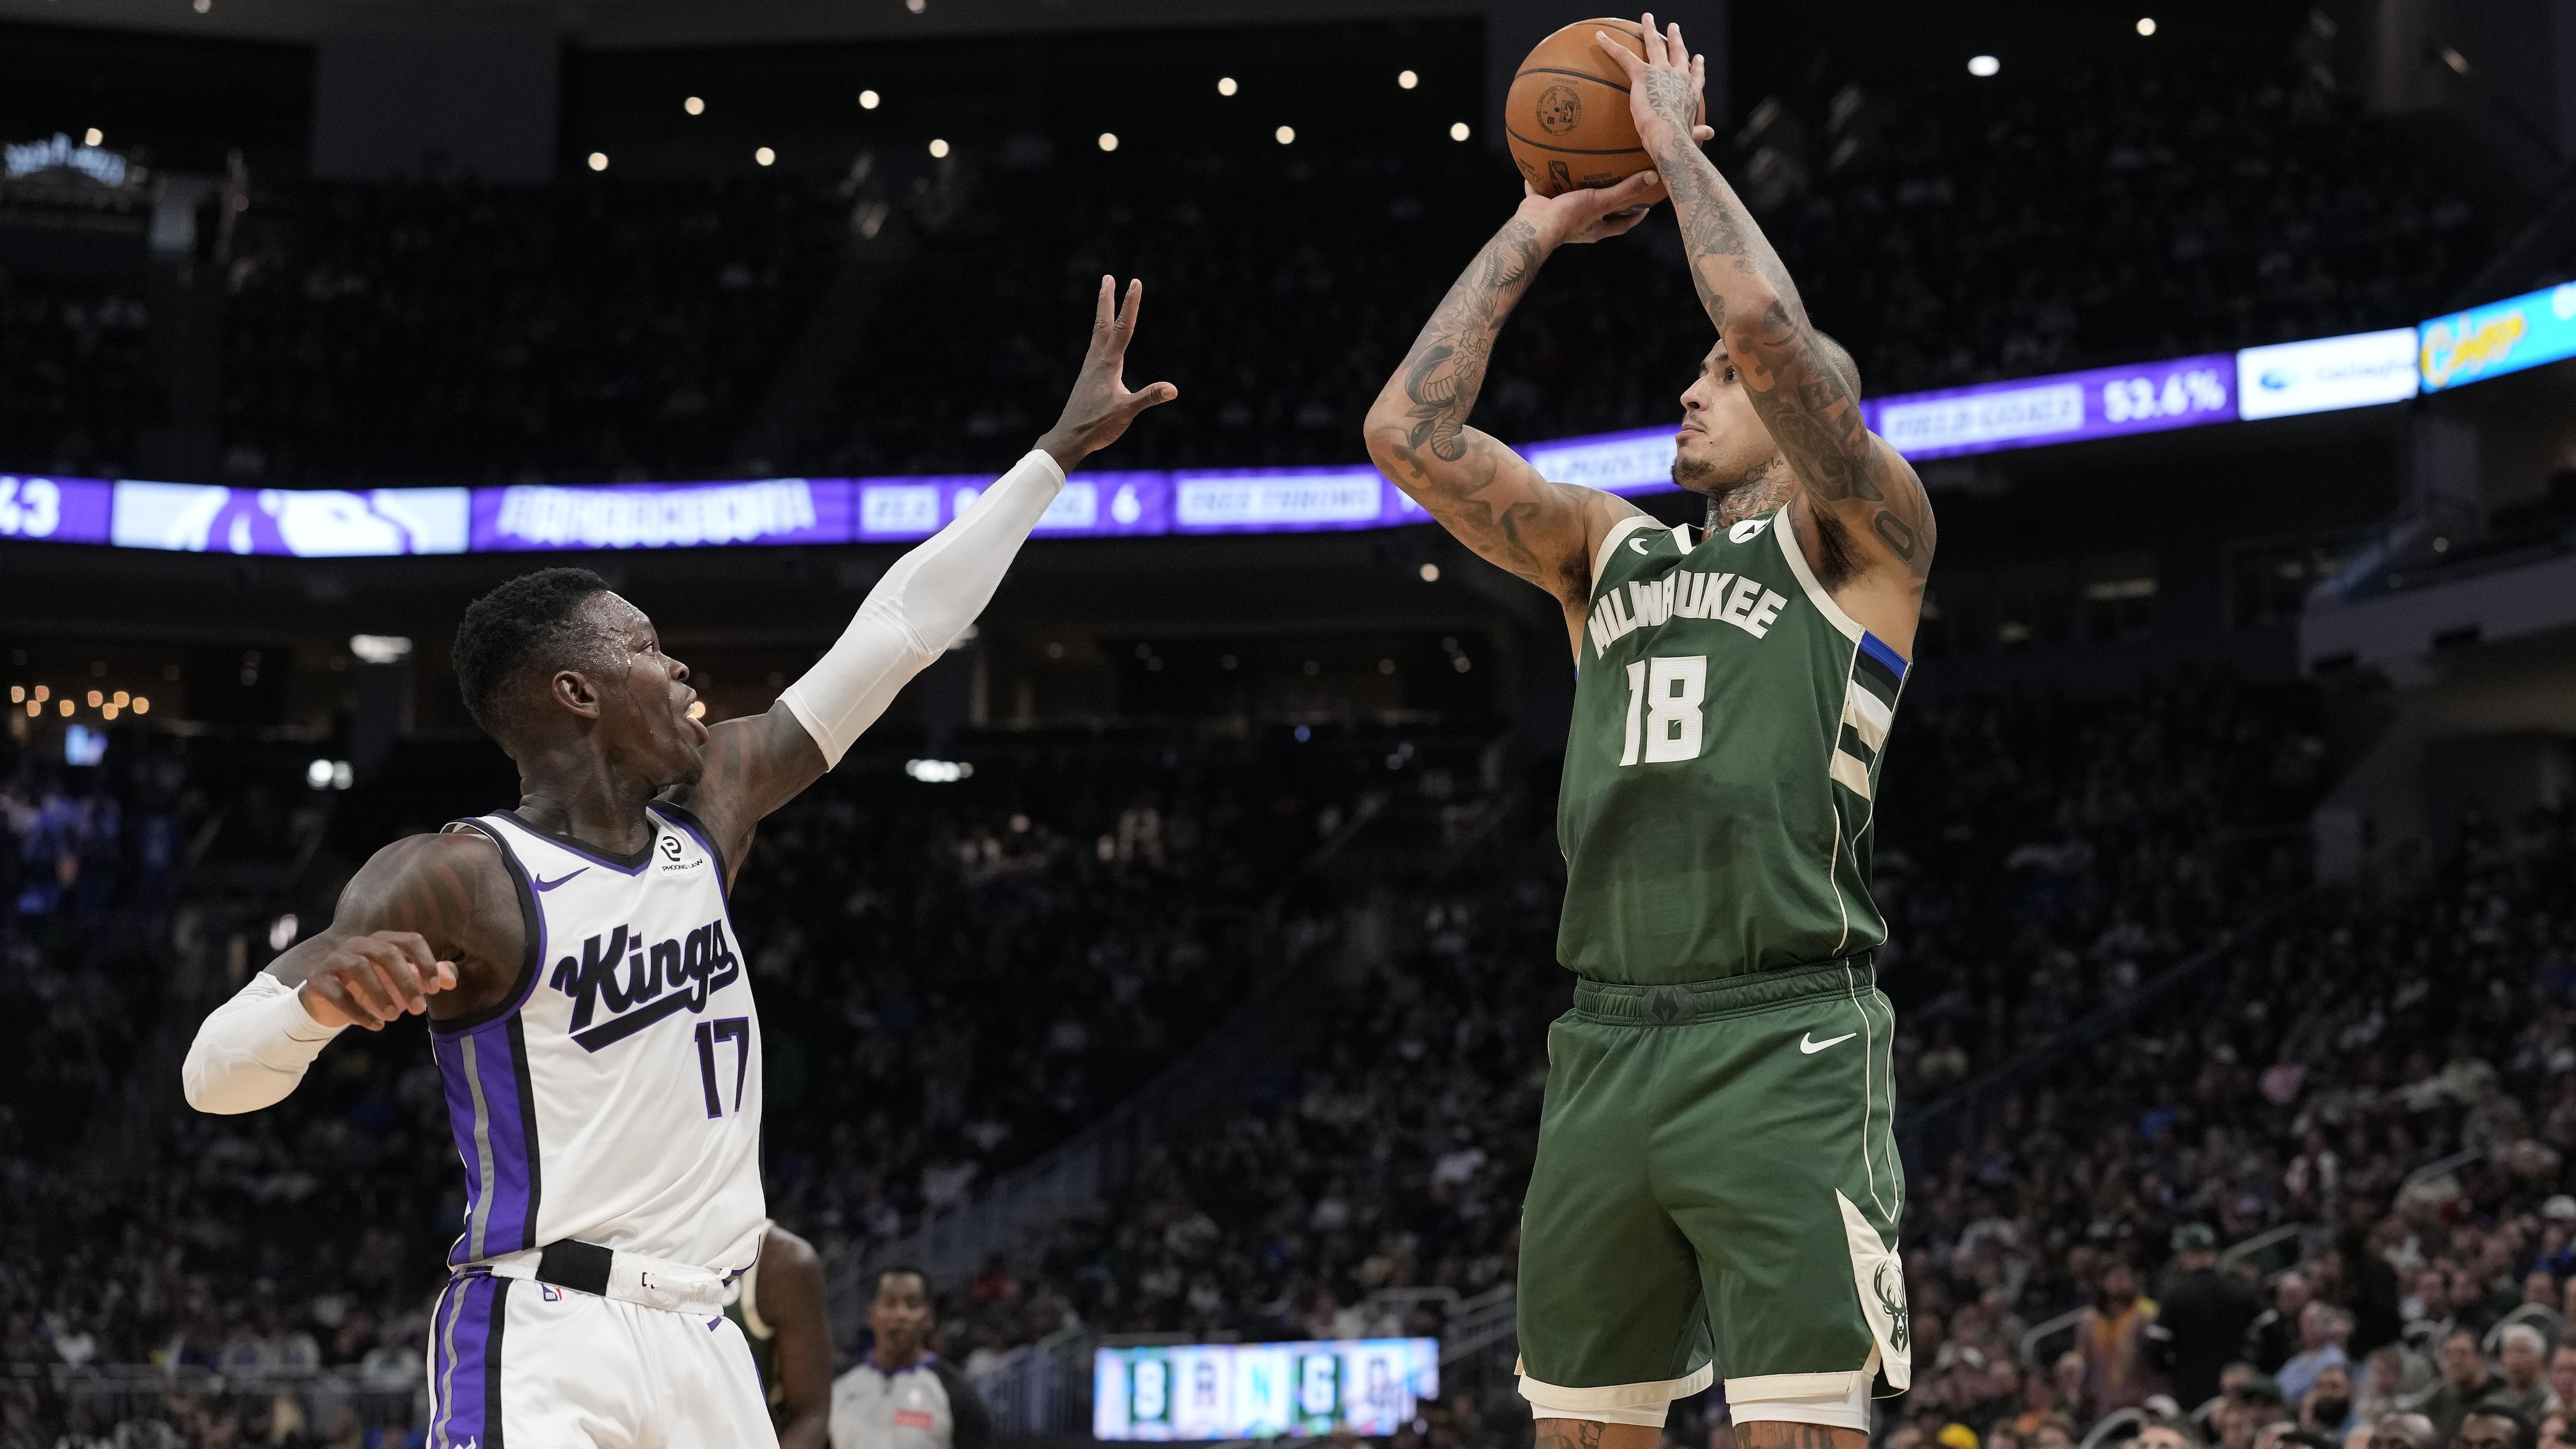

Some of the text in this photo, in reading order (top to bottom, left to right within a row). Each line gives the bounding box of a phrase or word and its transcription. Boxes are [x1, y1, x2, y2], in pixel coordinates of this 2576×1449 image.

[1588, 569, 1788, 661] MILWAUKEE
[1619, 655, 1707, 767] 18
[688, 858, 703, 868] LAW
[549, 918, 739, 1035] Kings
[694, 1016, 750, 1119] 17
